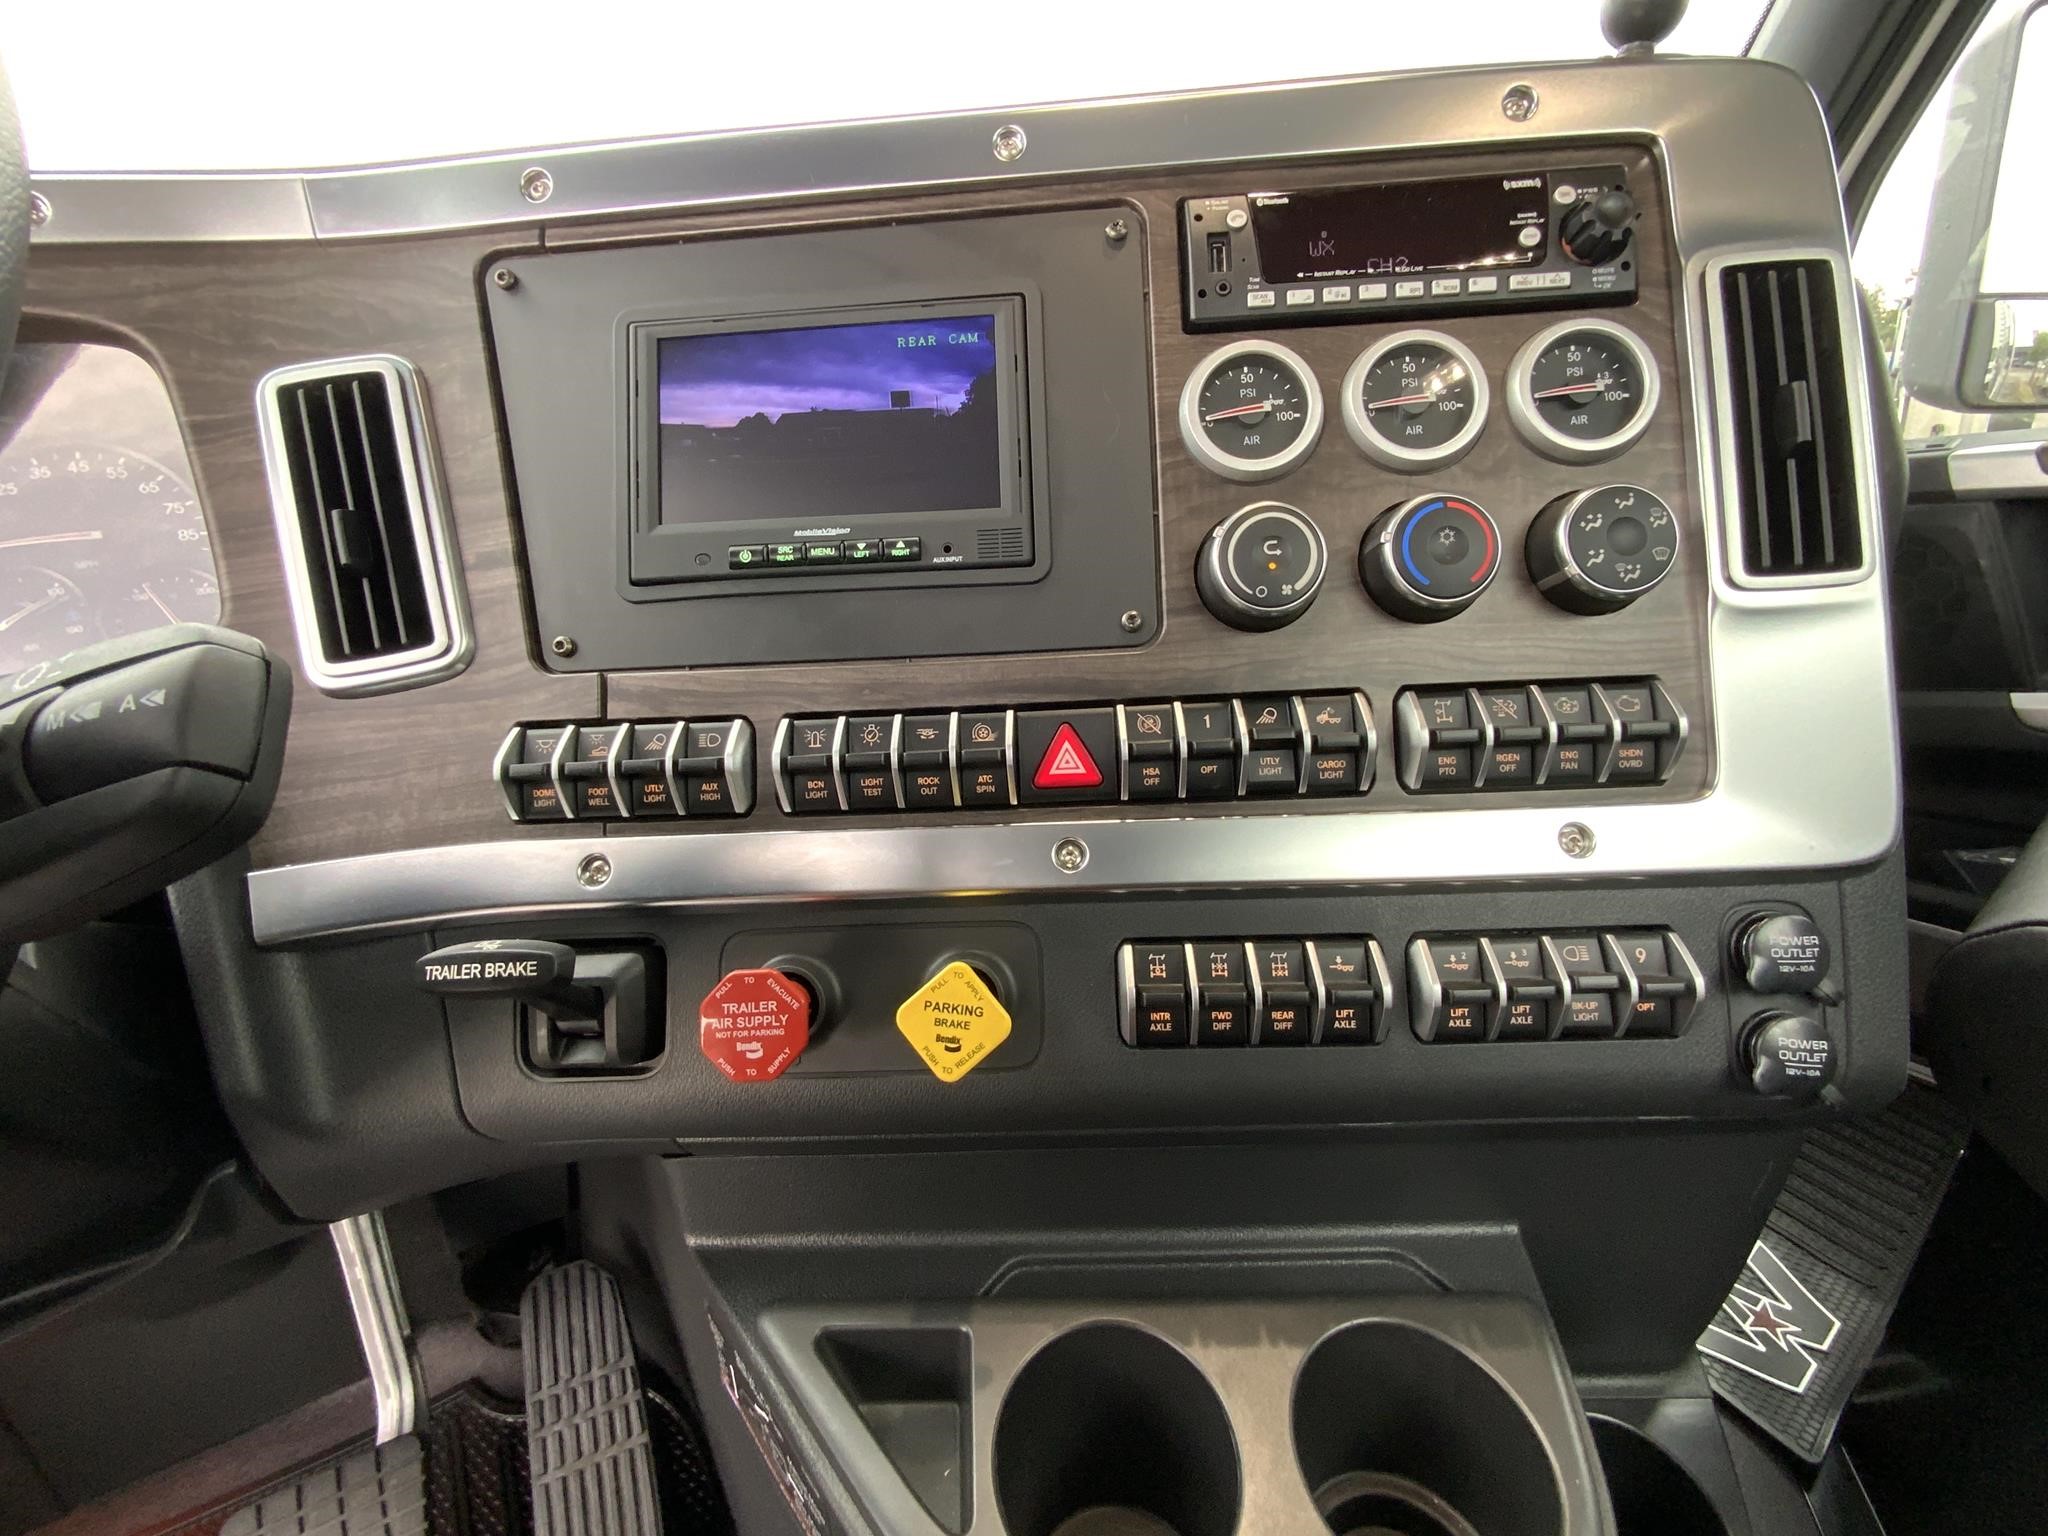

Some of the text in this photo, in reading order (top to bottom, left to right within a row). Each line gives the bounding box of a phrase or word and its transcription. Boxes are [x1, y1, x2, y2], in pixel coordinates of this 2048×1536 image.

[1309, 240, 1335, 256] WX
[897, 332, 979, 348] REAR CAM
[1567, 351, 1581, 362] 50
[1402, 363, 1416, 373] 50
[1566, 367, 1583, 377] PSI
[1240, 373, 1254, 383] 50
[1401, 378, 1418, 388] PSI
[1240, 388, 1256, 398] PSI
[1605, 391, 1622, 401] 100
[1438, 401, 1457, 411] 100
[1276, 411, 1294, 421] 100
[1570, 415, 1588, 425] AIR
[1405, 425, 1423, 435] AIR
[1243, 435, 1260, 446] AIR
[67, 461, 90, 473] 45
[29, 466, 52, 480] 35
[106, 467, 128, 479] 55
[0, 482, 18, 496] 25
[138, 481, 160, 494] 65
[162, 502, 185, 515] 75
[177, 529, 199, 541] 85
[777, 546, 794, 554] SRC
[810, 547, 835, 557] MENU
[853, 550, 870, 559] LEFT
[891, 549, 910, 557] RIGHT
[776, 554, 794, 562] REAR
[118, 694, 136, 713] A
[1202, 714, 1211, 729] 1
[1496, 752, 1520, 762] RGEN
[1560, 751, 1579, 760] ENG
[1618, 748, 1643, 758] SHDN
[1260, 756, 1280, 766] UTLY
[1317, 760, 1346, 770] CARGO
[1438, 756, 1456, 765] ENG
[1560, 760, 1578, 770] FAN
[1619, 759, 1643, 769] OVRD
[1142, 767, 1160, 776] HSA
[1201, 765, 1218, 774] OPT
[1258, 766, 1283, 776] LIGHT
[1438, 766, 1456, 775] PTO
[1499, 763, 1517, 772] OFF
[977, 774, 993, 783] ATC
[1319, 770, 1344, 779] LIGHT
[807, 780, 824, 789] BCN
[860, 777, 884, 787] LIGHT
[917, 776, 940, 786] ROCK
[1143, 777, 1160, 786] OFF
[644, 784, 664, 794] UTLY
[701, 782, 719, 791] AUX
[920, 786, 938, 795] OUT
[976, 784, 995, 793] SPIN
[533, 788, 556, 798] DOME
[588, 787, 608, 797] FOOT
[700, 791, 721, 801] HIGH
[805, 790, 828, 799] LIGHT
[863, 787, 882, 797] TEST
[533, 798, 556, 807] LIGHT
[587, 797, 610, 806] WELL
[643, 793, 667, 803] LIGHT
[1770, 935, 1820, 946] POWER
[1461, 952, 1467, 960] 2
[1521, 949, 1528, 957] 3
[1635, 947, 1647, 964] 9
[1771, 948, 1820, 958] OUTLET
[424, 961, 538, 981] TRAILER BRAKE
[930, 971, 984, 1001] PULL TO APPLY
[715, 976, 800, 1010] PULL TO EVACUATE
[722, 1001, 778, 1014] TRAILER
[924, 1000, 985, 1018] PARKING
[1512, 1005, 1531, 1015] LIFT
[1571, 1001, 1598, 1011] BK-UP
[1636, 1002, 1655, 1012] OPT
[1150, 1012, 1171, 1021] INTR
[1211, 1011, 1233, 1020] FWD
[1271, 1011, 1294, 1020] REAR
[1335, 1009, 1354, 1019] LIFT
[1450, 1007, 1469, 1017] LIFT
[1573, 1012, 1599, 1022] LIGHT
[711, 1014, 789, 1029] AIR SUPPLY
[934, 1018, 971, 1030] BRAKE
[1273, 1020, 1293, 1030] DIFF
[1333, 1019, 1356, 1029] AXLE
[1448, 1018, 1472, 1028] AXLE
[1510, 1015, 1533, 1025] AXLE
[1150, 1022, 1172, 1031] AXLE
[1213, 1021, 1232, 1030] DIFF
[715, 1028, 785, 1039] NOT FOR PARKING
[935, 1034, 962, 1044] Bendix
[1778, 1037, 1828, 1050] POWER
[923, 1042, 985, 1075] PUSH TO RELEASE
[1779, 1050, 1828, 1062] OUTLET
[718, 1047, 791, 1076] PUSH TO SUPPLY
